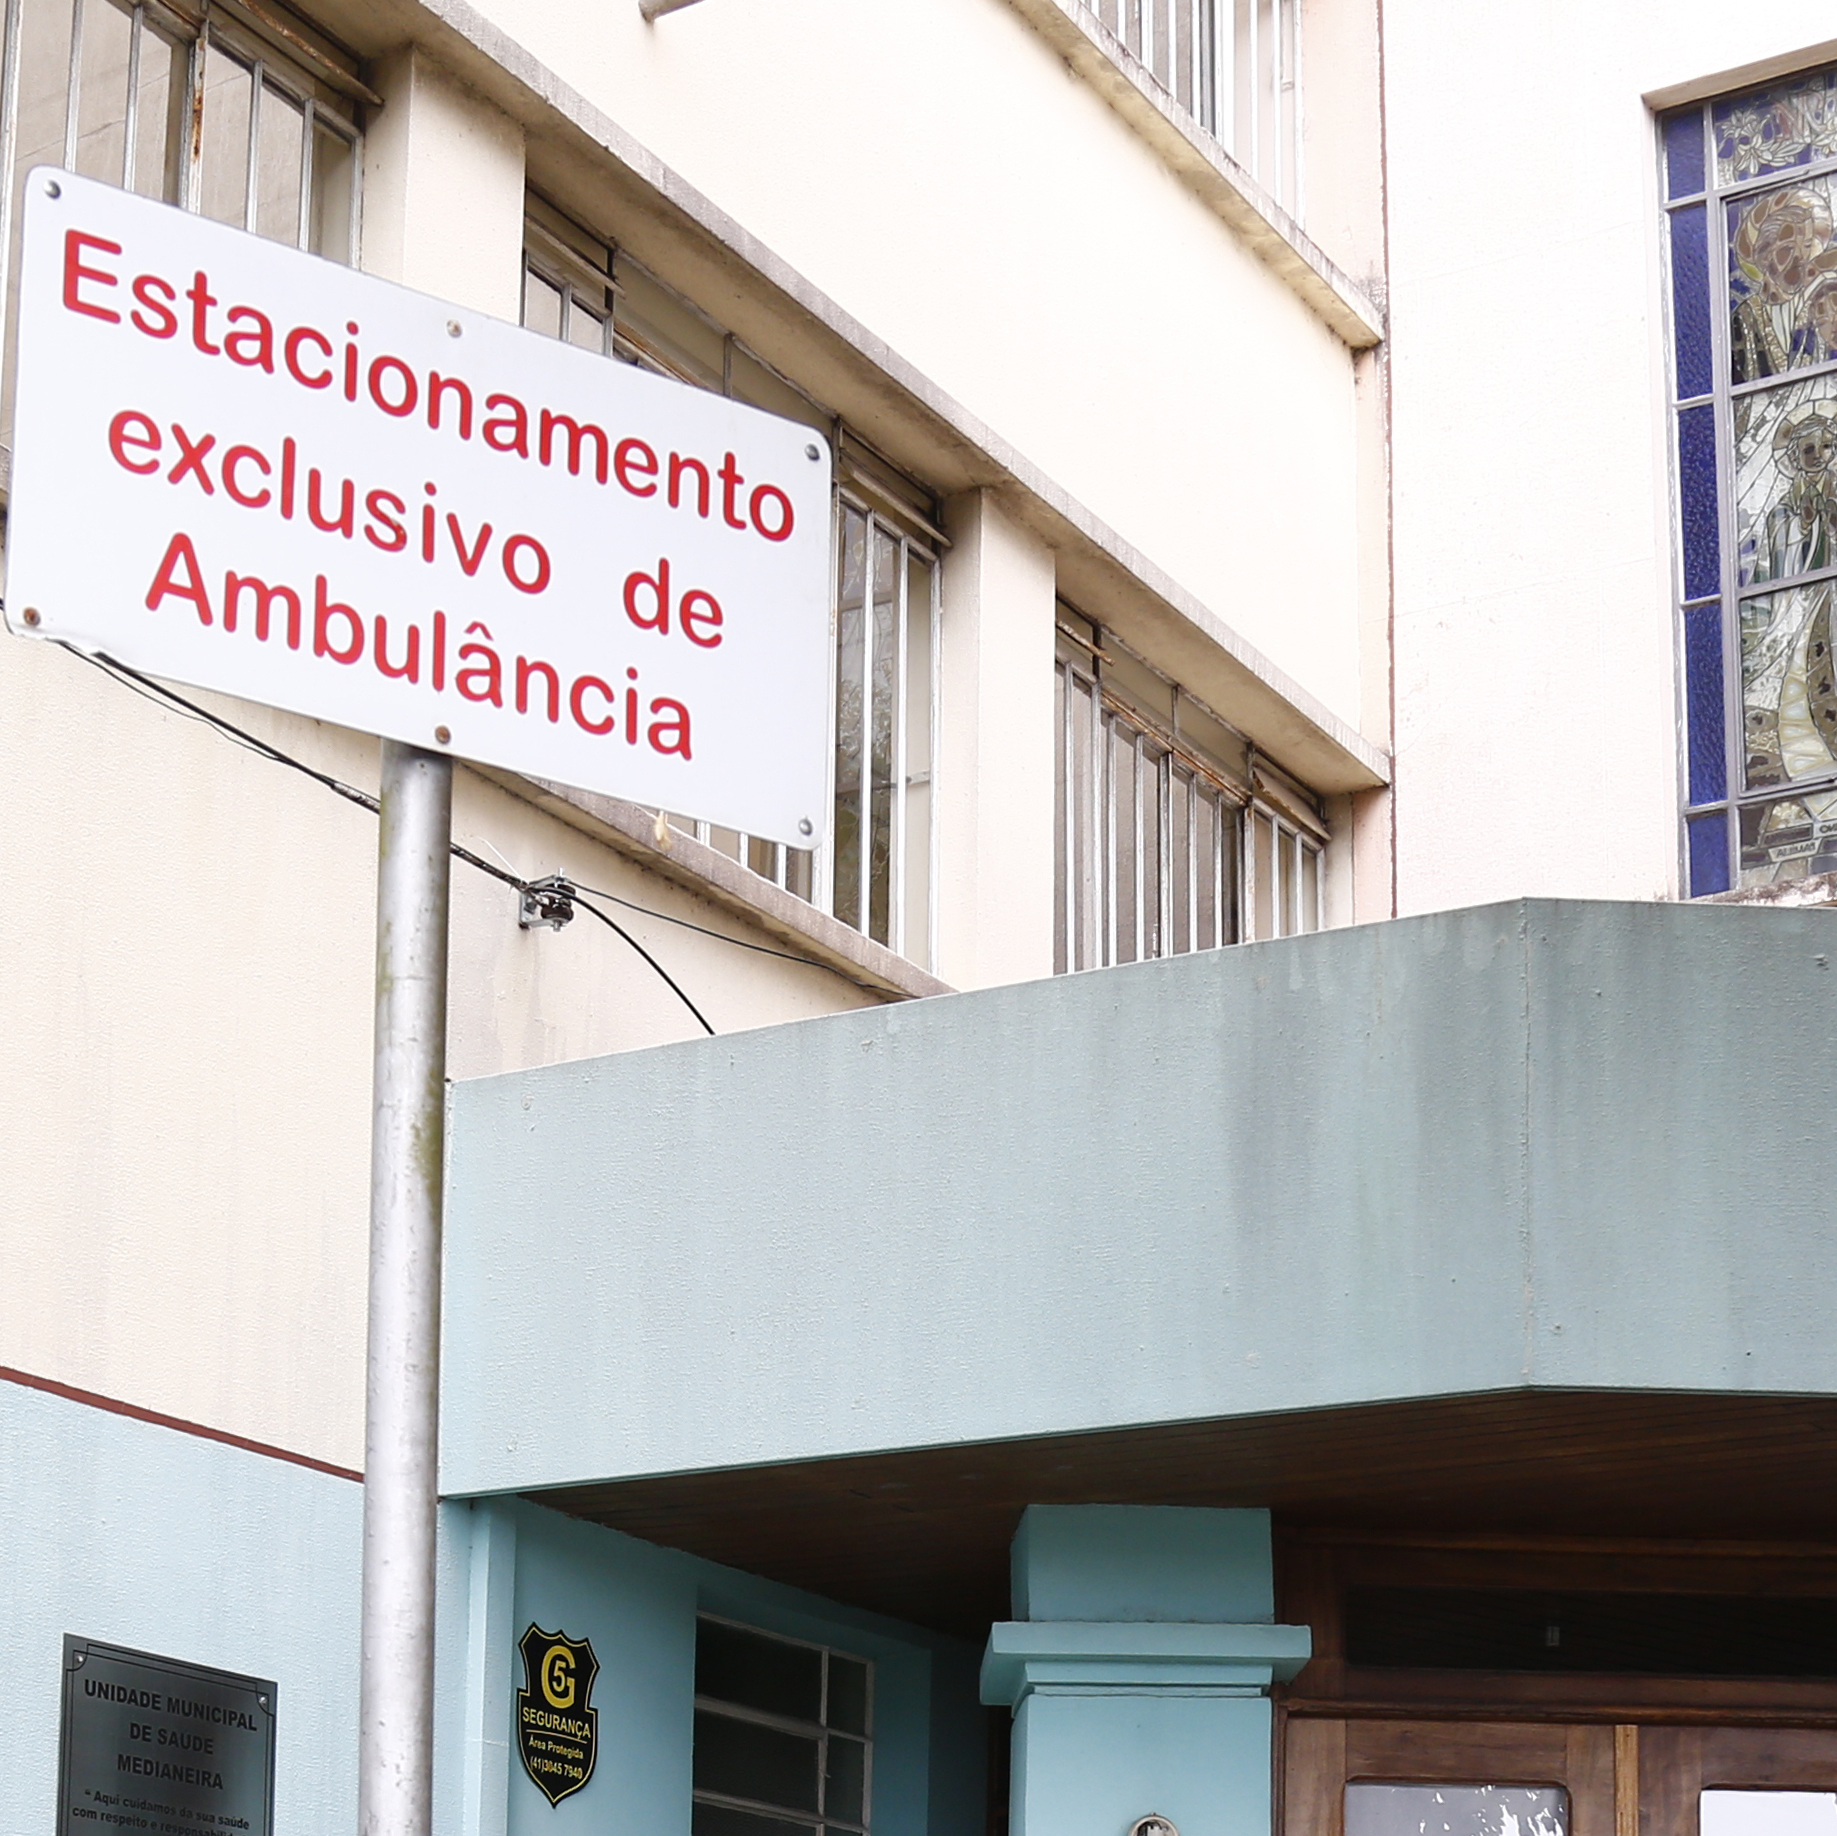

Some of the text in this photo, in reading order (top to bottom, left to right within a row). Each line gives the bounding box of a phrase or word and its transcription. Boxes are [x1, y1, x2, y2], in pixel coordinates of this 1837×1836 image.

[63, 228, 795, 542] Estacionamento
[108, 409, 724, 649] exclusivo de
[144, 531, 693, 761] Ambulância
[84, 1679, 258, 1731] UNIDADE MUNICIPAL
[522, 1706, 591, 1740] SEGURANÇA
[129, 1722, 152, 1742] DE
[548, 1741, 584, 1760] Protegida
[117, 1754, 224, 1790] MEDIANEIRA
[72, 1807, 97, 1821] com
[101, 1812, 148, 1829] respeito
[150, 1820, 158, 1830] e
[94, 1790, 121, 1807] Aqui
[123, 1794, 177, 1816] cuidamos
[179, 1806, 194, 1819] da
[196, 1812, 215, 1824] sua
[218, 1813, 250, 1830] saúde
